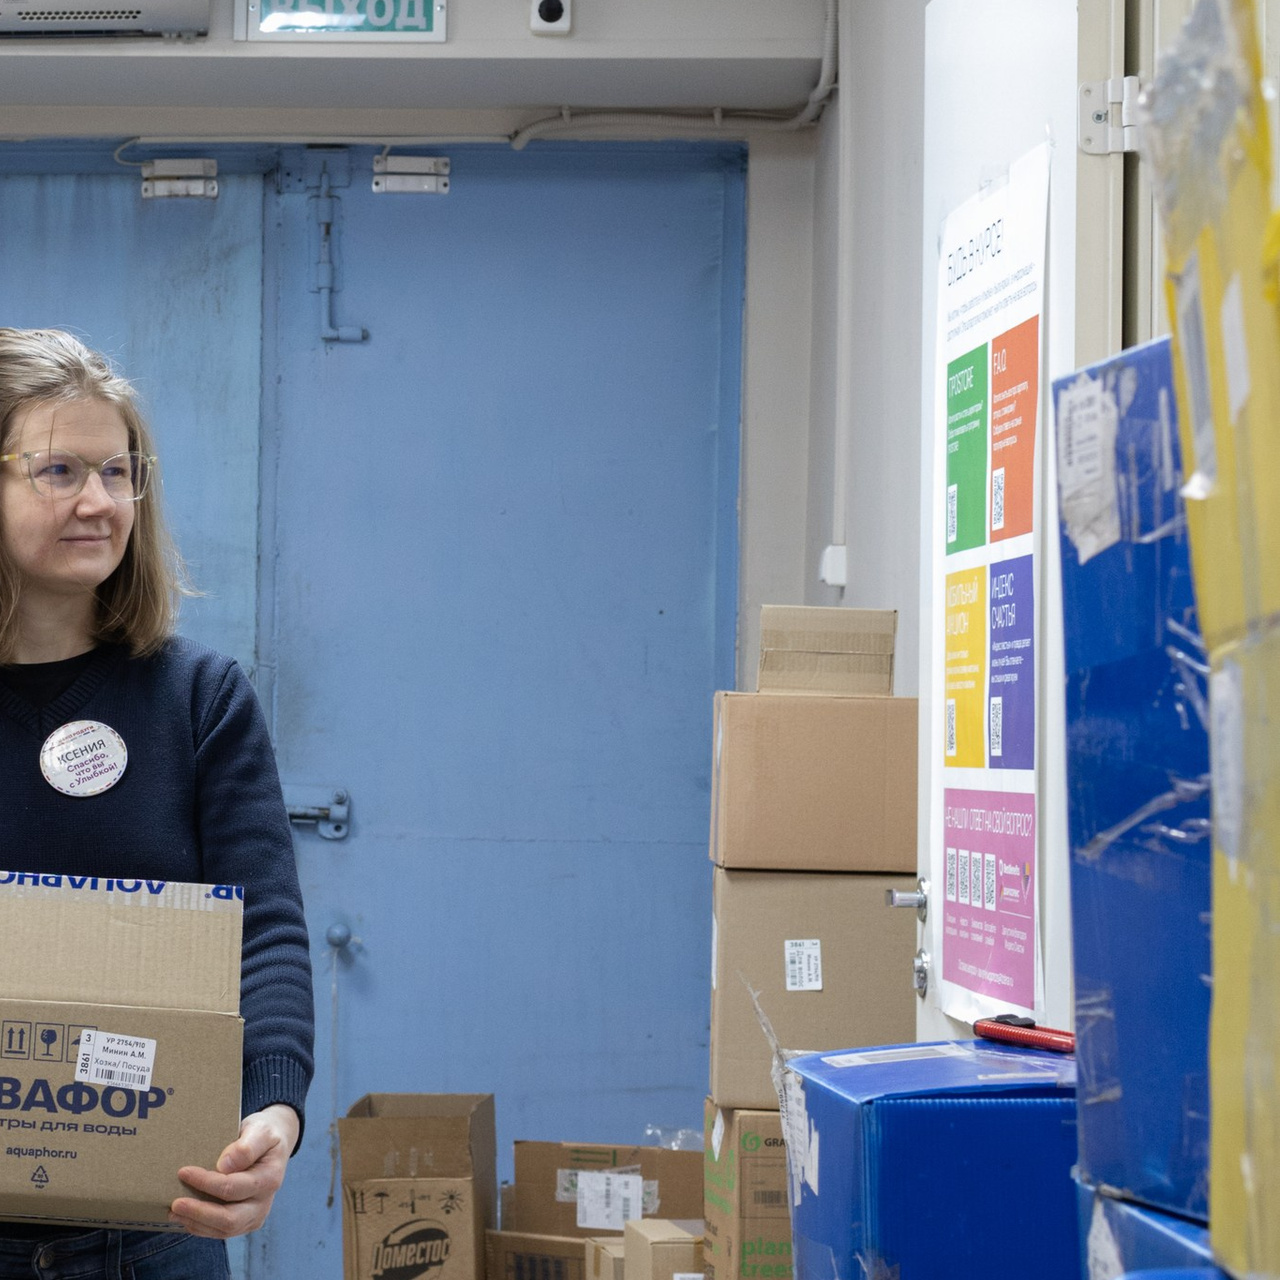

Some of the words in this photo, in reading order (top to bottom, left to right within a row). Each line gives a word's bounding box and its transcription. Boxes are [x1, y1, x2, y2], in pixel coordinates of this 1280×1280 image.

[992, 573, 1014, 599] ИНДЕКС
[992, 603, 1016, 629] СЧАСТЬЯ
[57, 739, 106, 765] КСЕНИЯ
[67, 752, 109, 772] Спасибо,
[76, 766, 91, 777] что
[92, 761, 105, 771] вы
[75, 762, 118, 786] Улыбкой!
[85, 1033, 92, 1042] 3
[102, 1046, 128, 1056] Минин
[80, 1053, 91, 1074] 3861
[122, 1061, 151, 1073] Посуда
[40, 1120, 78, 1132] для
[83, 1123, 137, 1136] воды
[6, 1145, 78, 1160] aquaphor.ru
